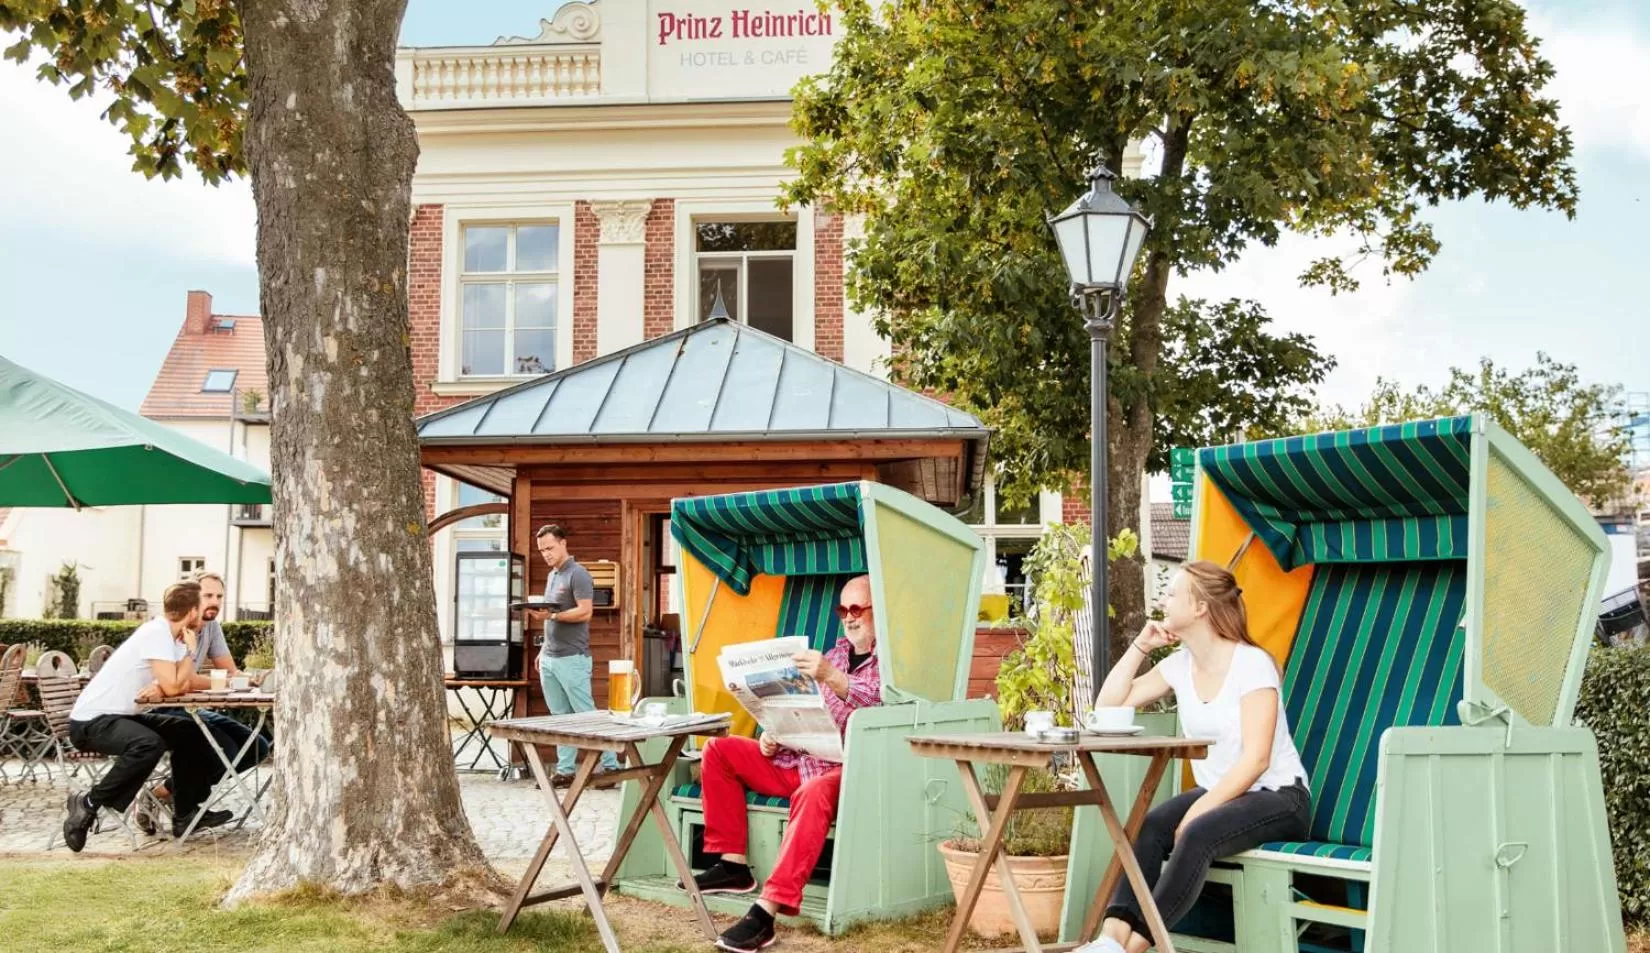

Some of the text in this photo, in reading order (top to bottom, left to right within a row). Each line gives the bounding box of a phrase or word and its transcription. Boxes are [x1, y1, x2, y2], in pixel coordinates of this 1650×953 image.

[658, 10, 832, 45] Prinz Heinrich
[680, 48, 808, 67] HOTEL & CAFÉ
